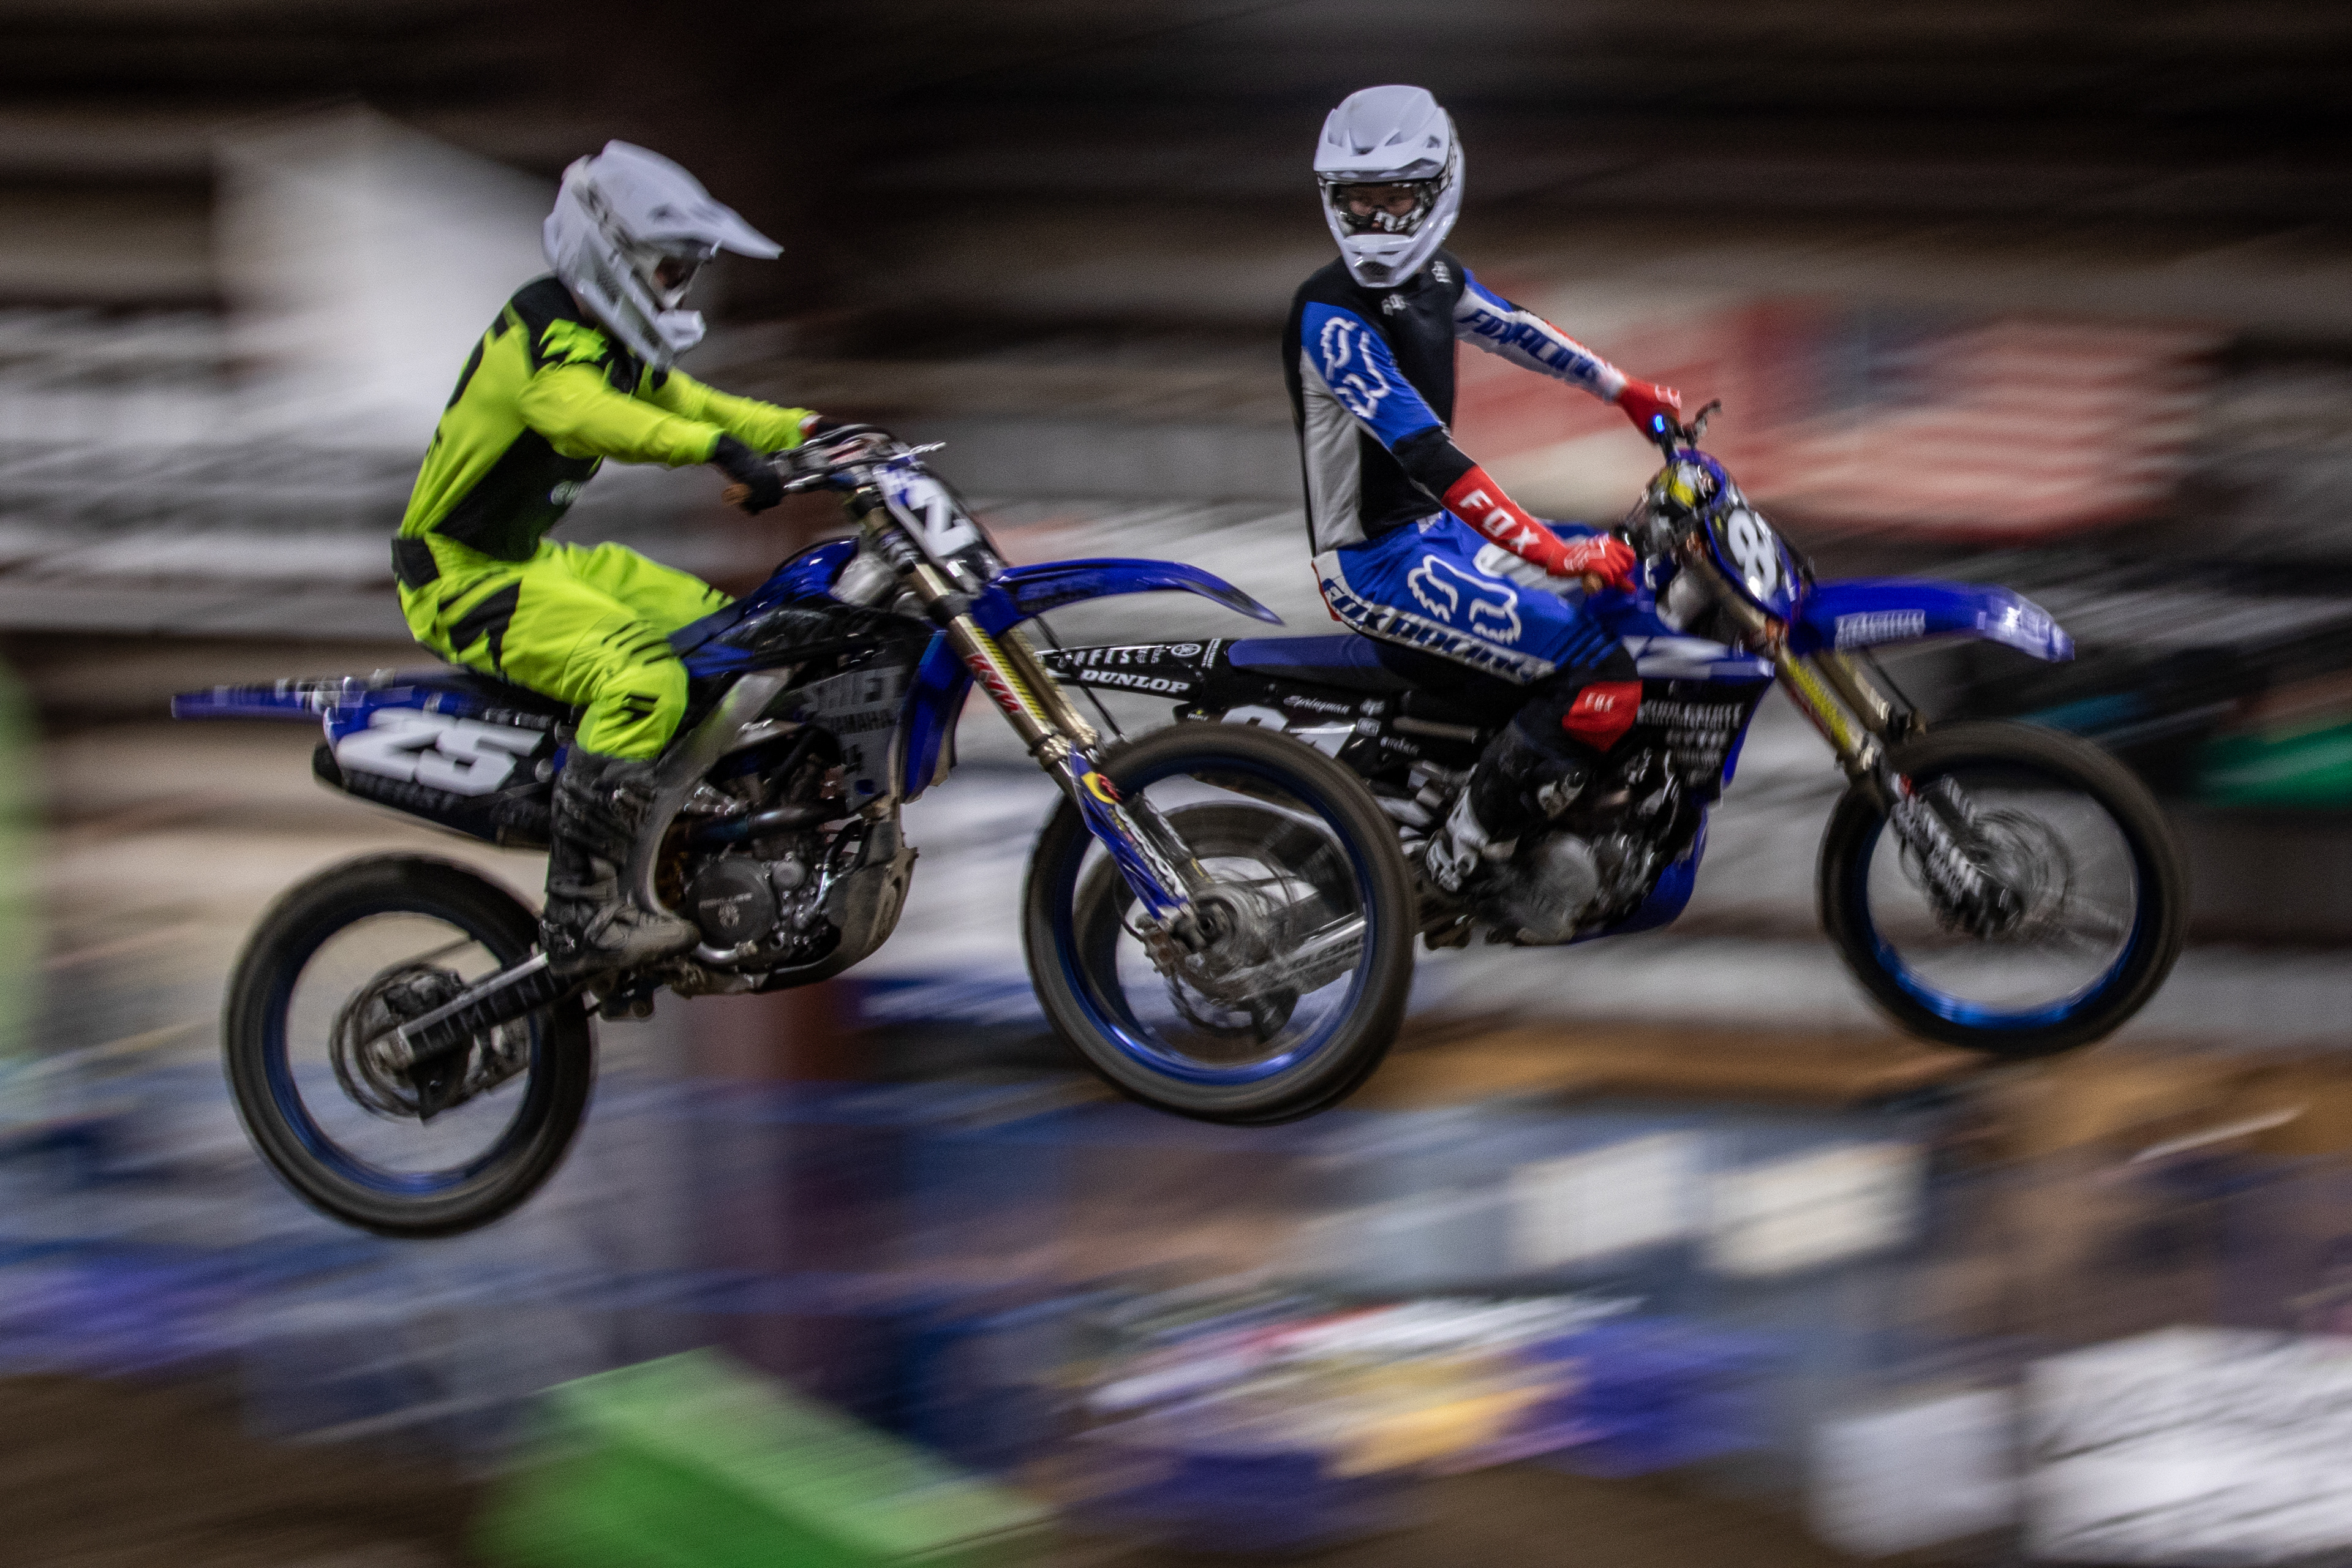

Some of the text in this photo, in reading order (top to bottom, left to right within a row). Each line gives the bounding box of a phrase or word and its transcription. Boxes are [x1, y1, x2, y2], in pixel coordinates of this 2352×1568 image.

[1459, 489, 1540, 555] FOX
[1322, 578, 1389, 631] FOX
[1079, 669, 1190, 693] DUNLOP
[335, 707, 546, 796] 25
